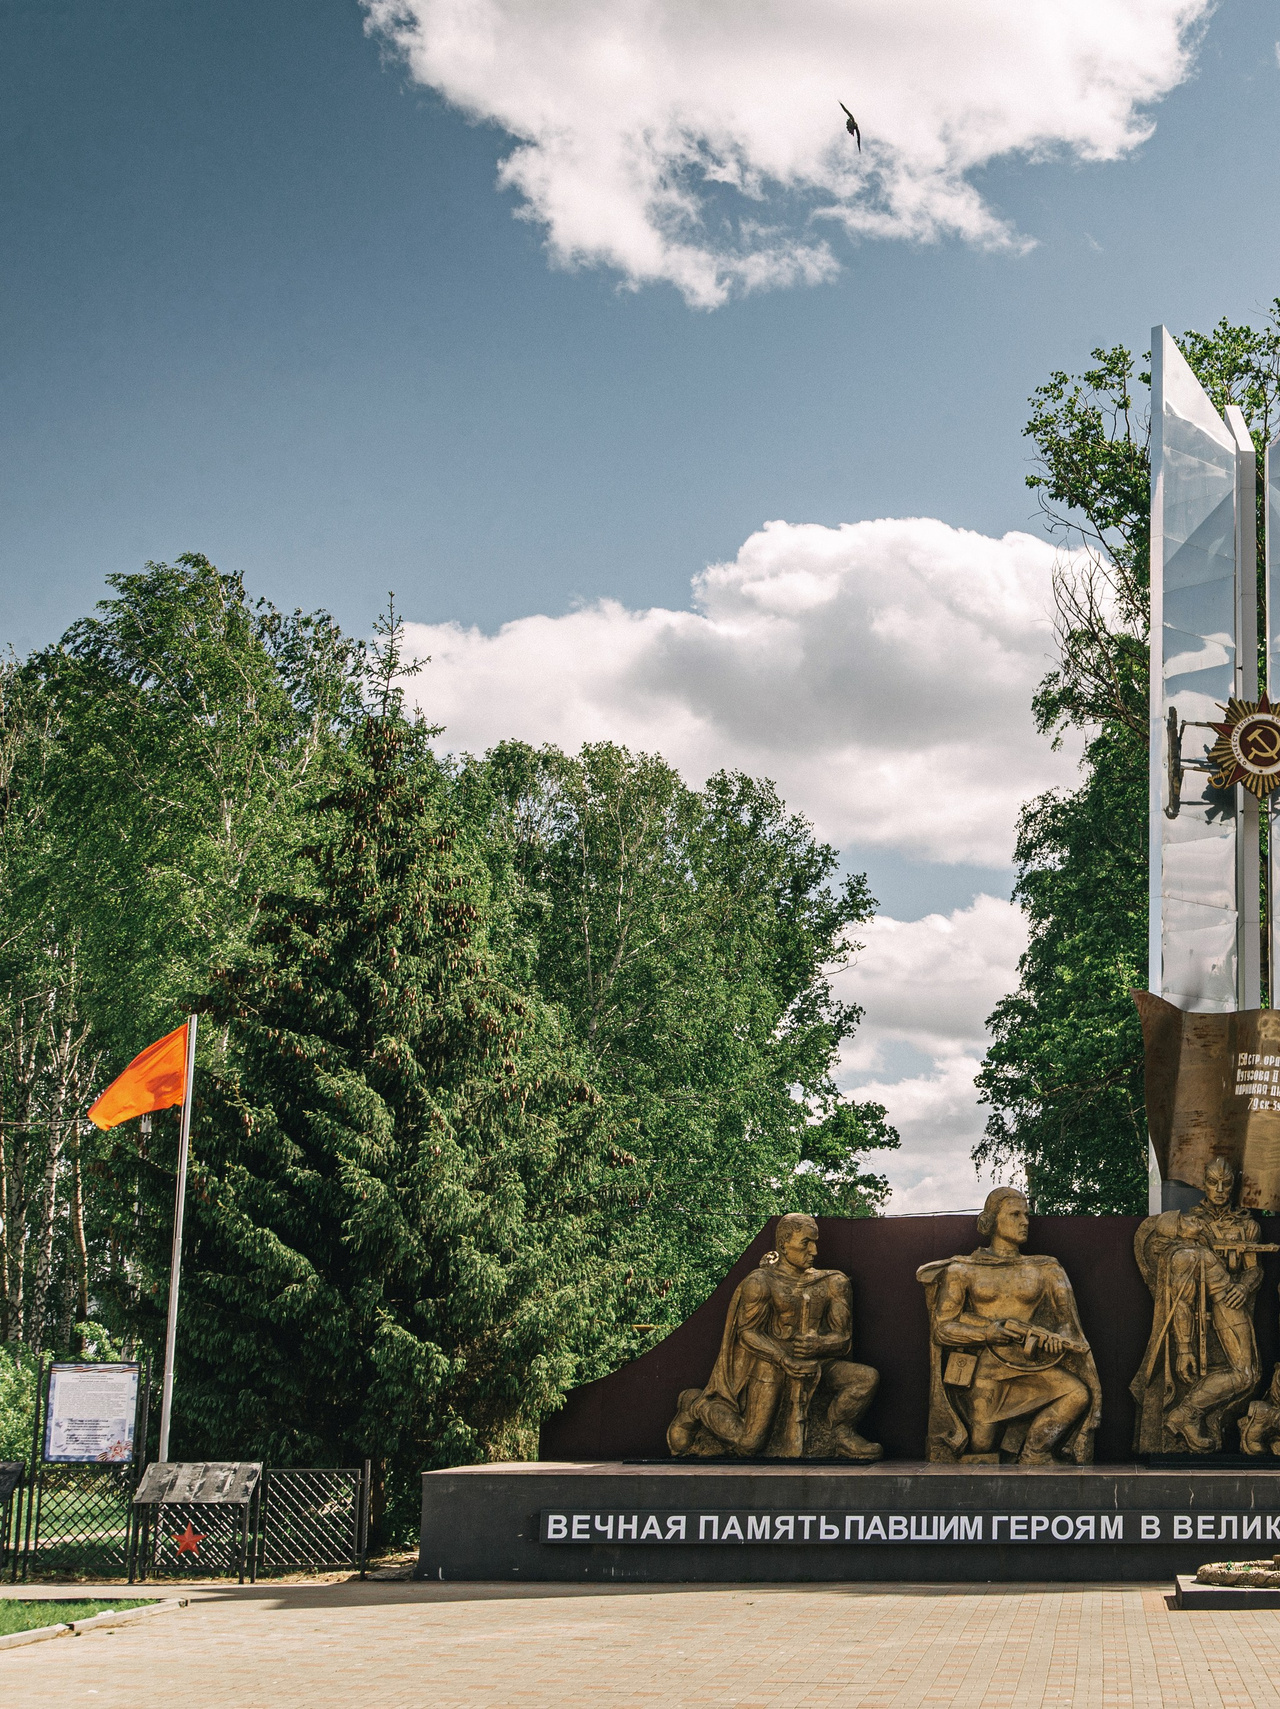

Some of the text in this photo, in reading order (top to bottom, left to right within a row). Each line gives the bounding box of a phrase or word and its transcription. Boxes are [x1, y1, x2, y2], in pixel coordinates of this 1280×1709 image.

[548, 1515, 686, 1539] ВЕЧНАЯ
[699, 1516, 839, 1540] ПАМЯТЬ
[845, 1516, 982, 1540] ПАВШИМ
[992, 1516, 1123, 1540] ГЕРОЯМ
[1141, 1516, 1160, 1539] В
